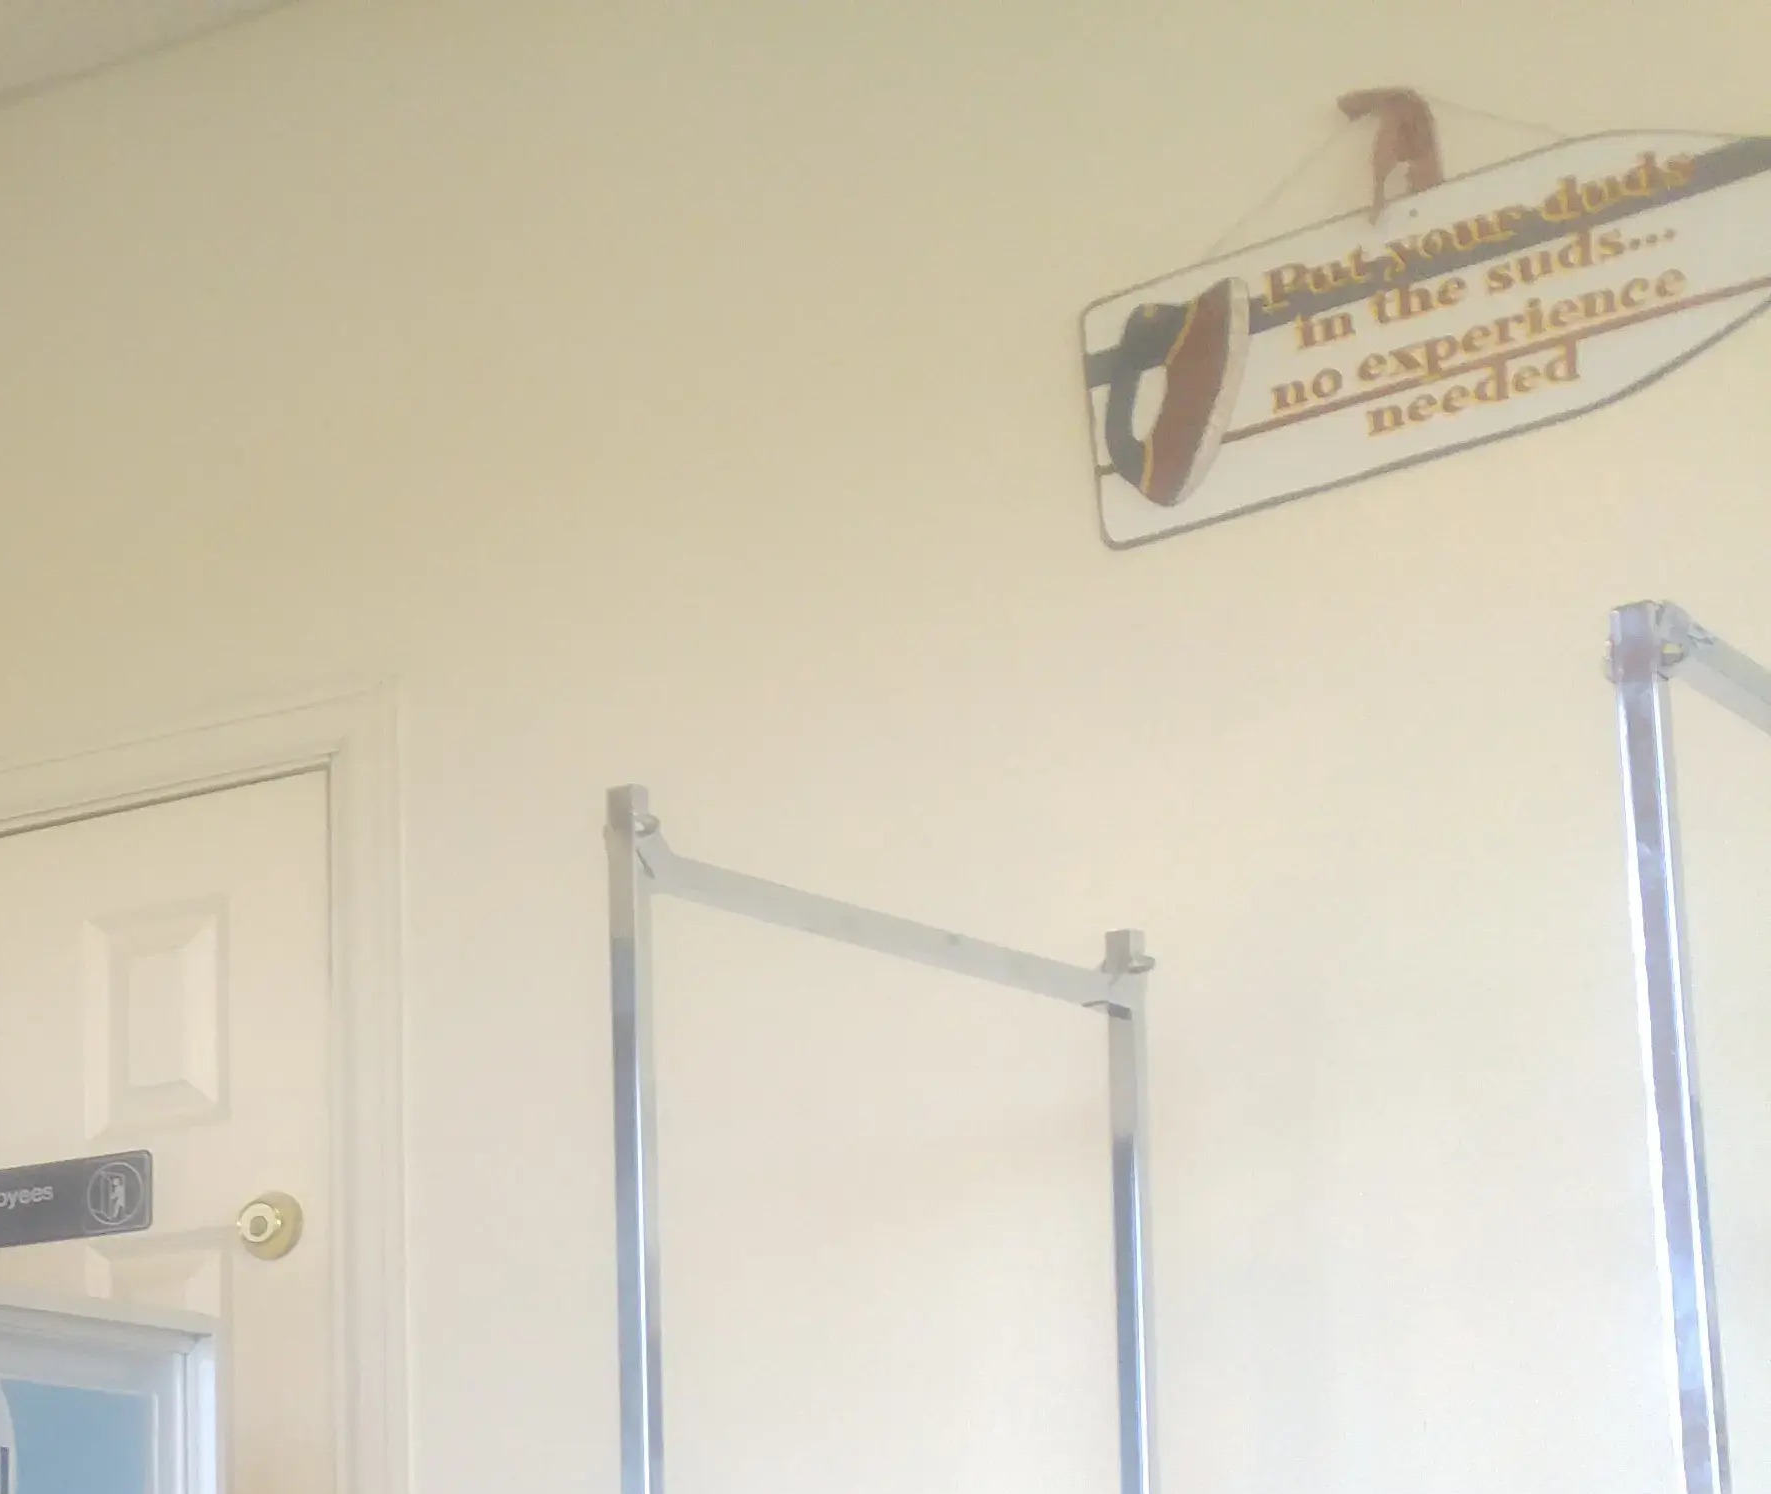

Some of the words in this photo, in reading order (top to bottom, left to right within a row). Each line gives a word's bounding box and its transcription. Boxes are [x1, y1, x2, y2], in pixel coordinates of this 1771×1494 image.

[1261, 245, 1374, 313] Put
[1383, 204, 1522, 281] your
[1539, 151, 1697, 221] duds
[1294, 311, 1356, 350] in
[1368, 275, 1468, 324] the
[1484, 228, 1678, 295] suds...
[1271, 367, 1344, 415] no
[1357, 267, 1687, 378] experience
[1366, 337, 1581, 436] needed
